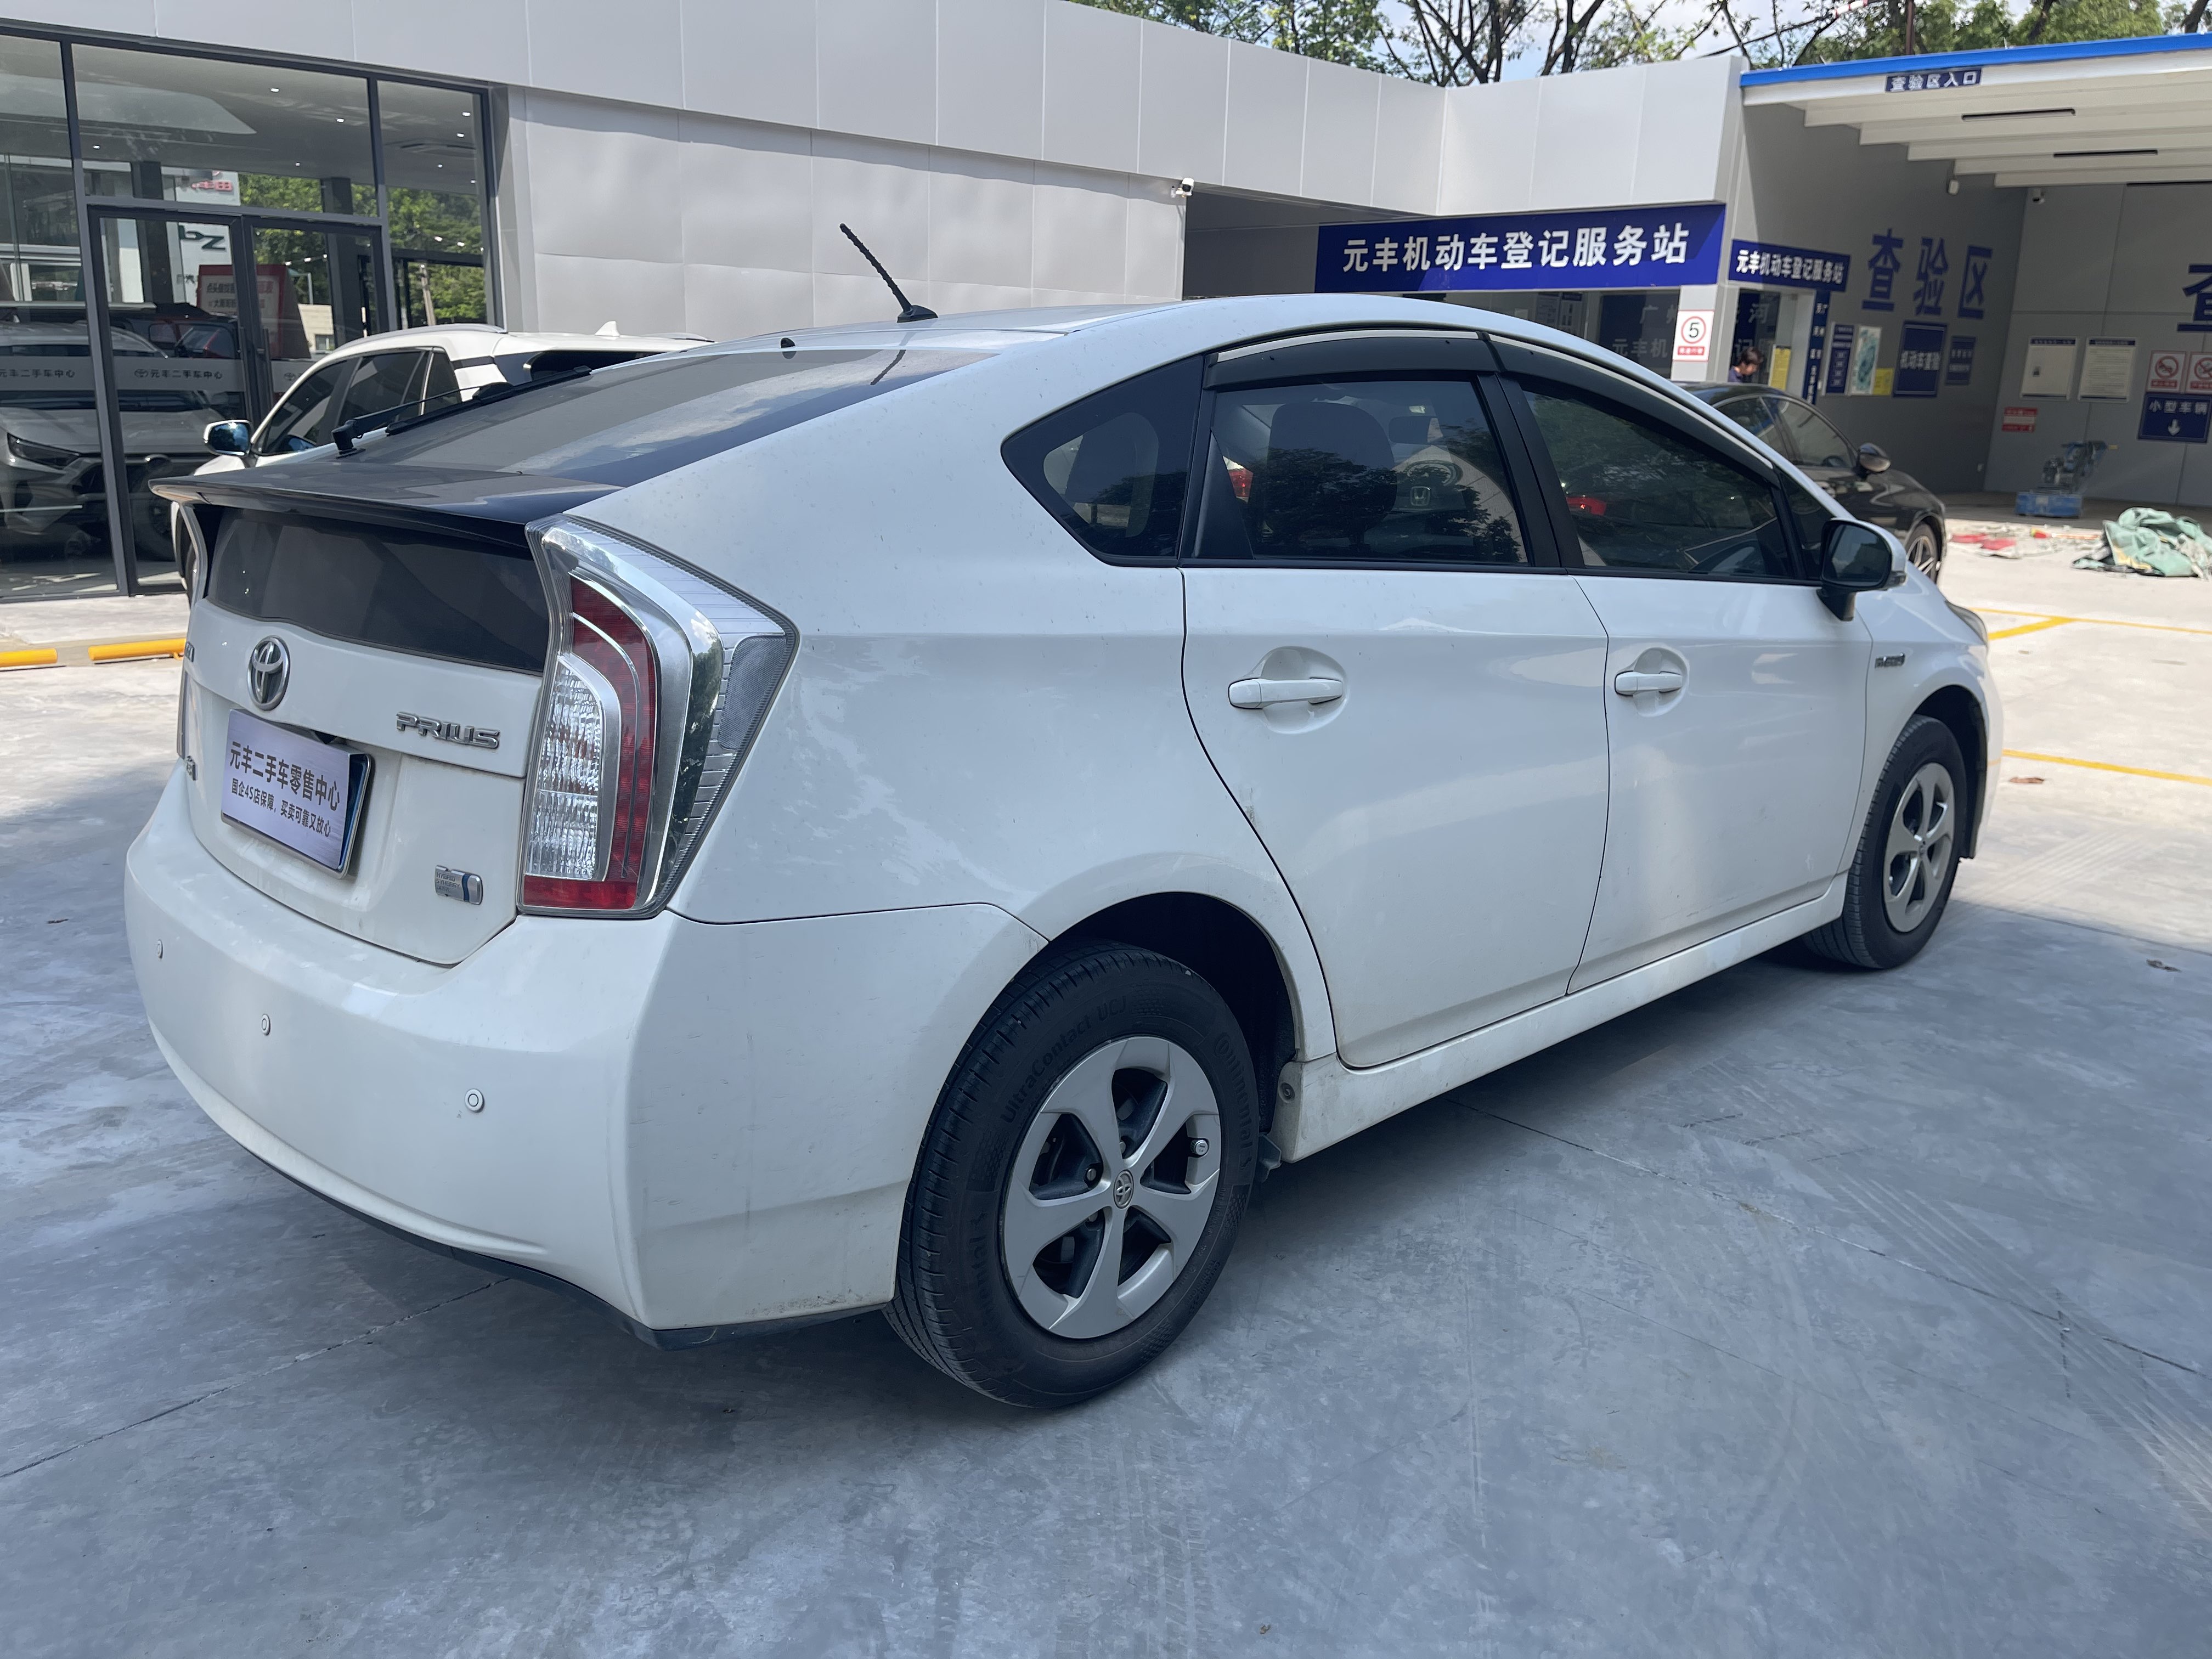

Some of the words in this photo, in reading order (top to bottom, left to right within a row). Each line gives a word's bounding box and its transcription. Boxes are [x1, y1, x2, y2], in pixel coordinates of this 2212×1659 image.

[1891, 71, 1977, 92] 查验区入口
[1343, 223, 1689, 273] 元丰机动车登记服务站
[1736, 249, 1845, 285] 元丰机动车登记服务站
[1861, 228, 1993, 319] 查验区
[1688, 323, 1700, 338] 5
[150, 369, 223, 380] 元丰二手车中心
[396, 712, 500, 749] PRIUS
[229, 741, 340, 811] 元丰二手车零售中心
[436, 872, 455, 882] HYBRID
[1000, 1014, 1092, 1123] UltraContact
[1097, 996, 1127, 1022] UCJ
